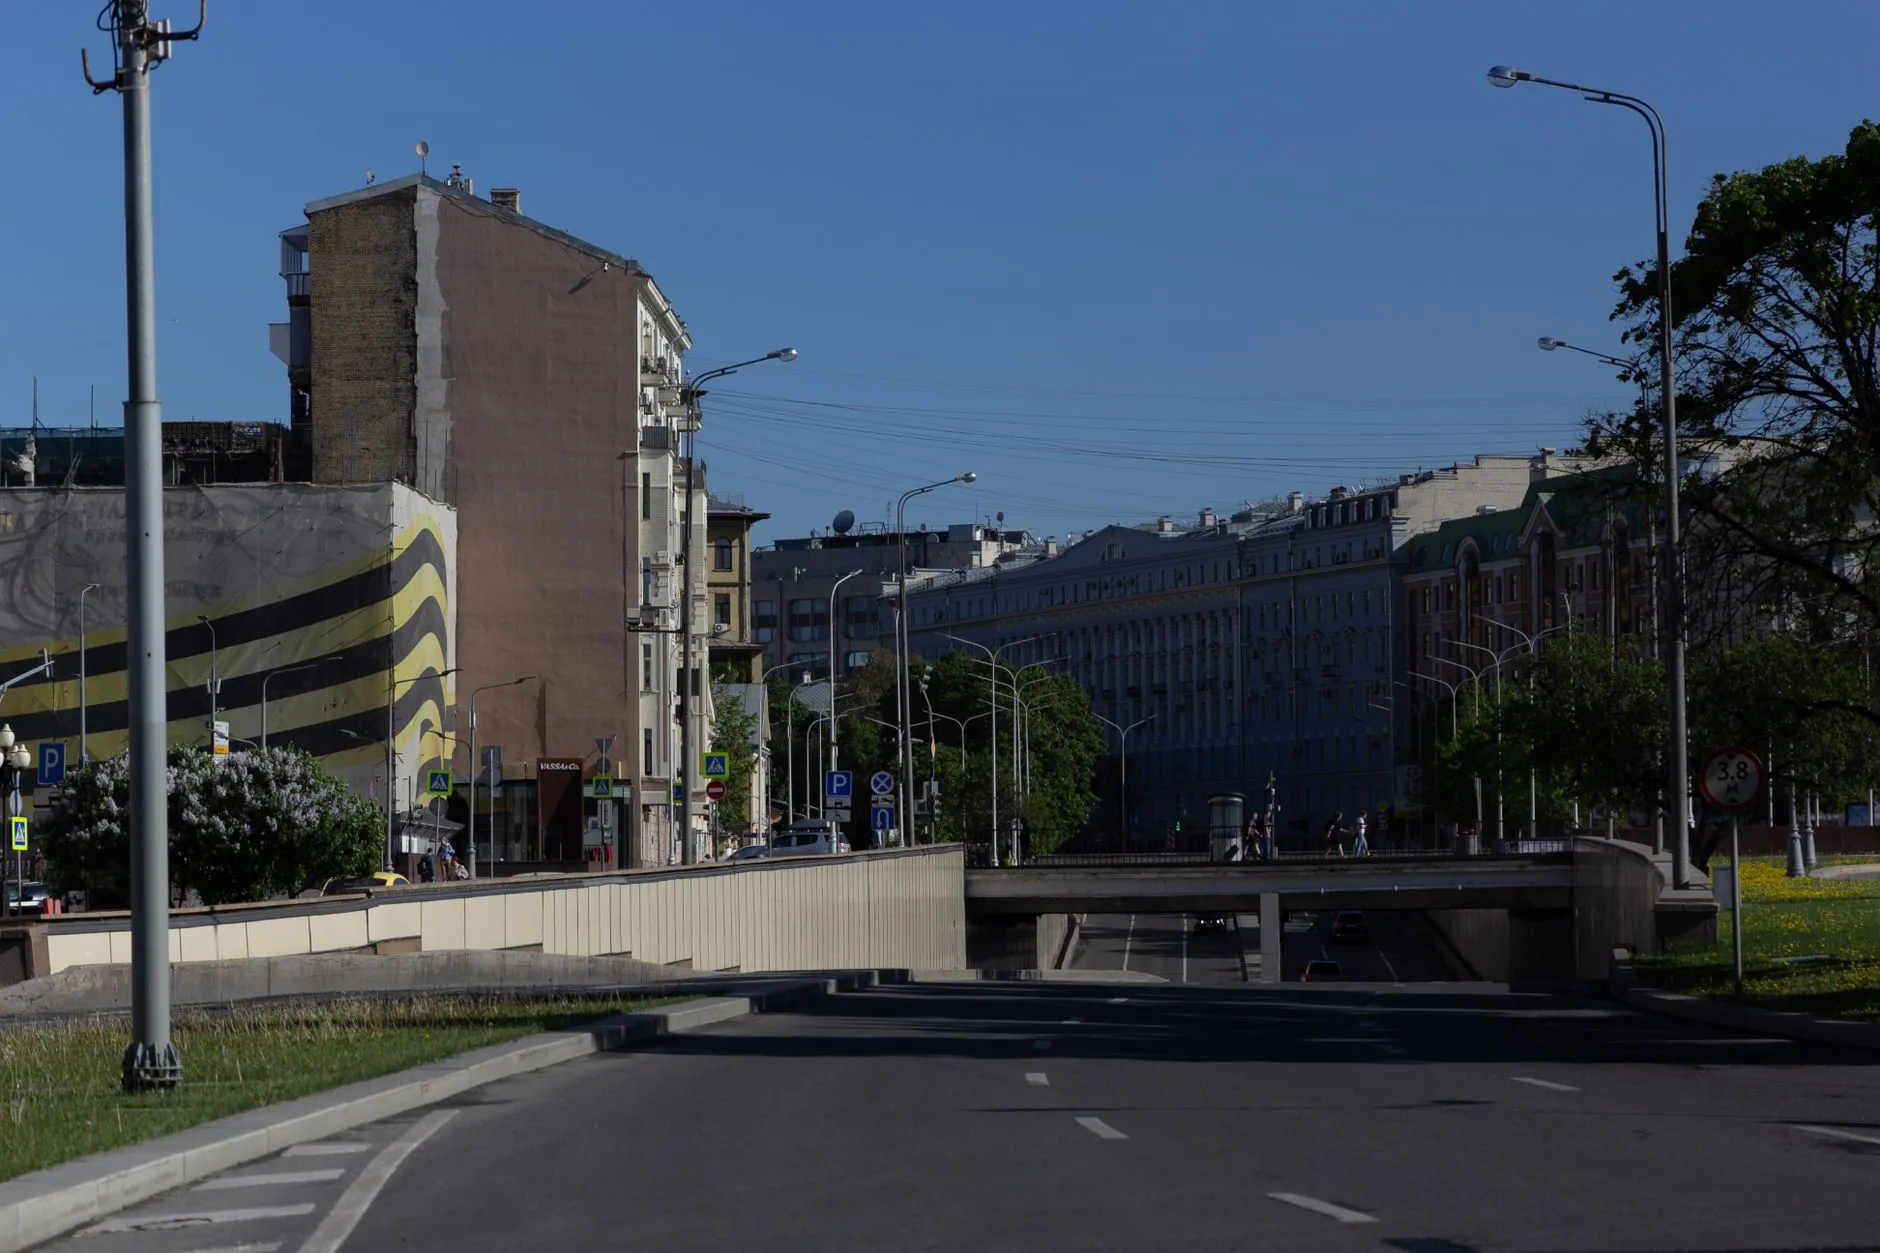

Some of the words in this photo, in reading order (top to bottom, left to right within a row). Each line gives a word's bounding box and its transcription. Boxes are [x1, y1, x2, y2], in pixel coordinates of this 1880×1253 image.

[45, 748, 59, 780] P
[1717, 761, 1748, 780] 3.8
[833, 774, 847, 794] P
